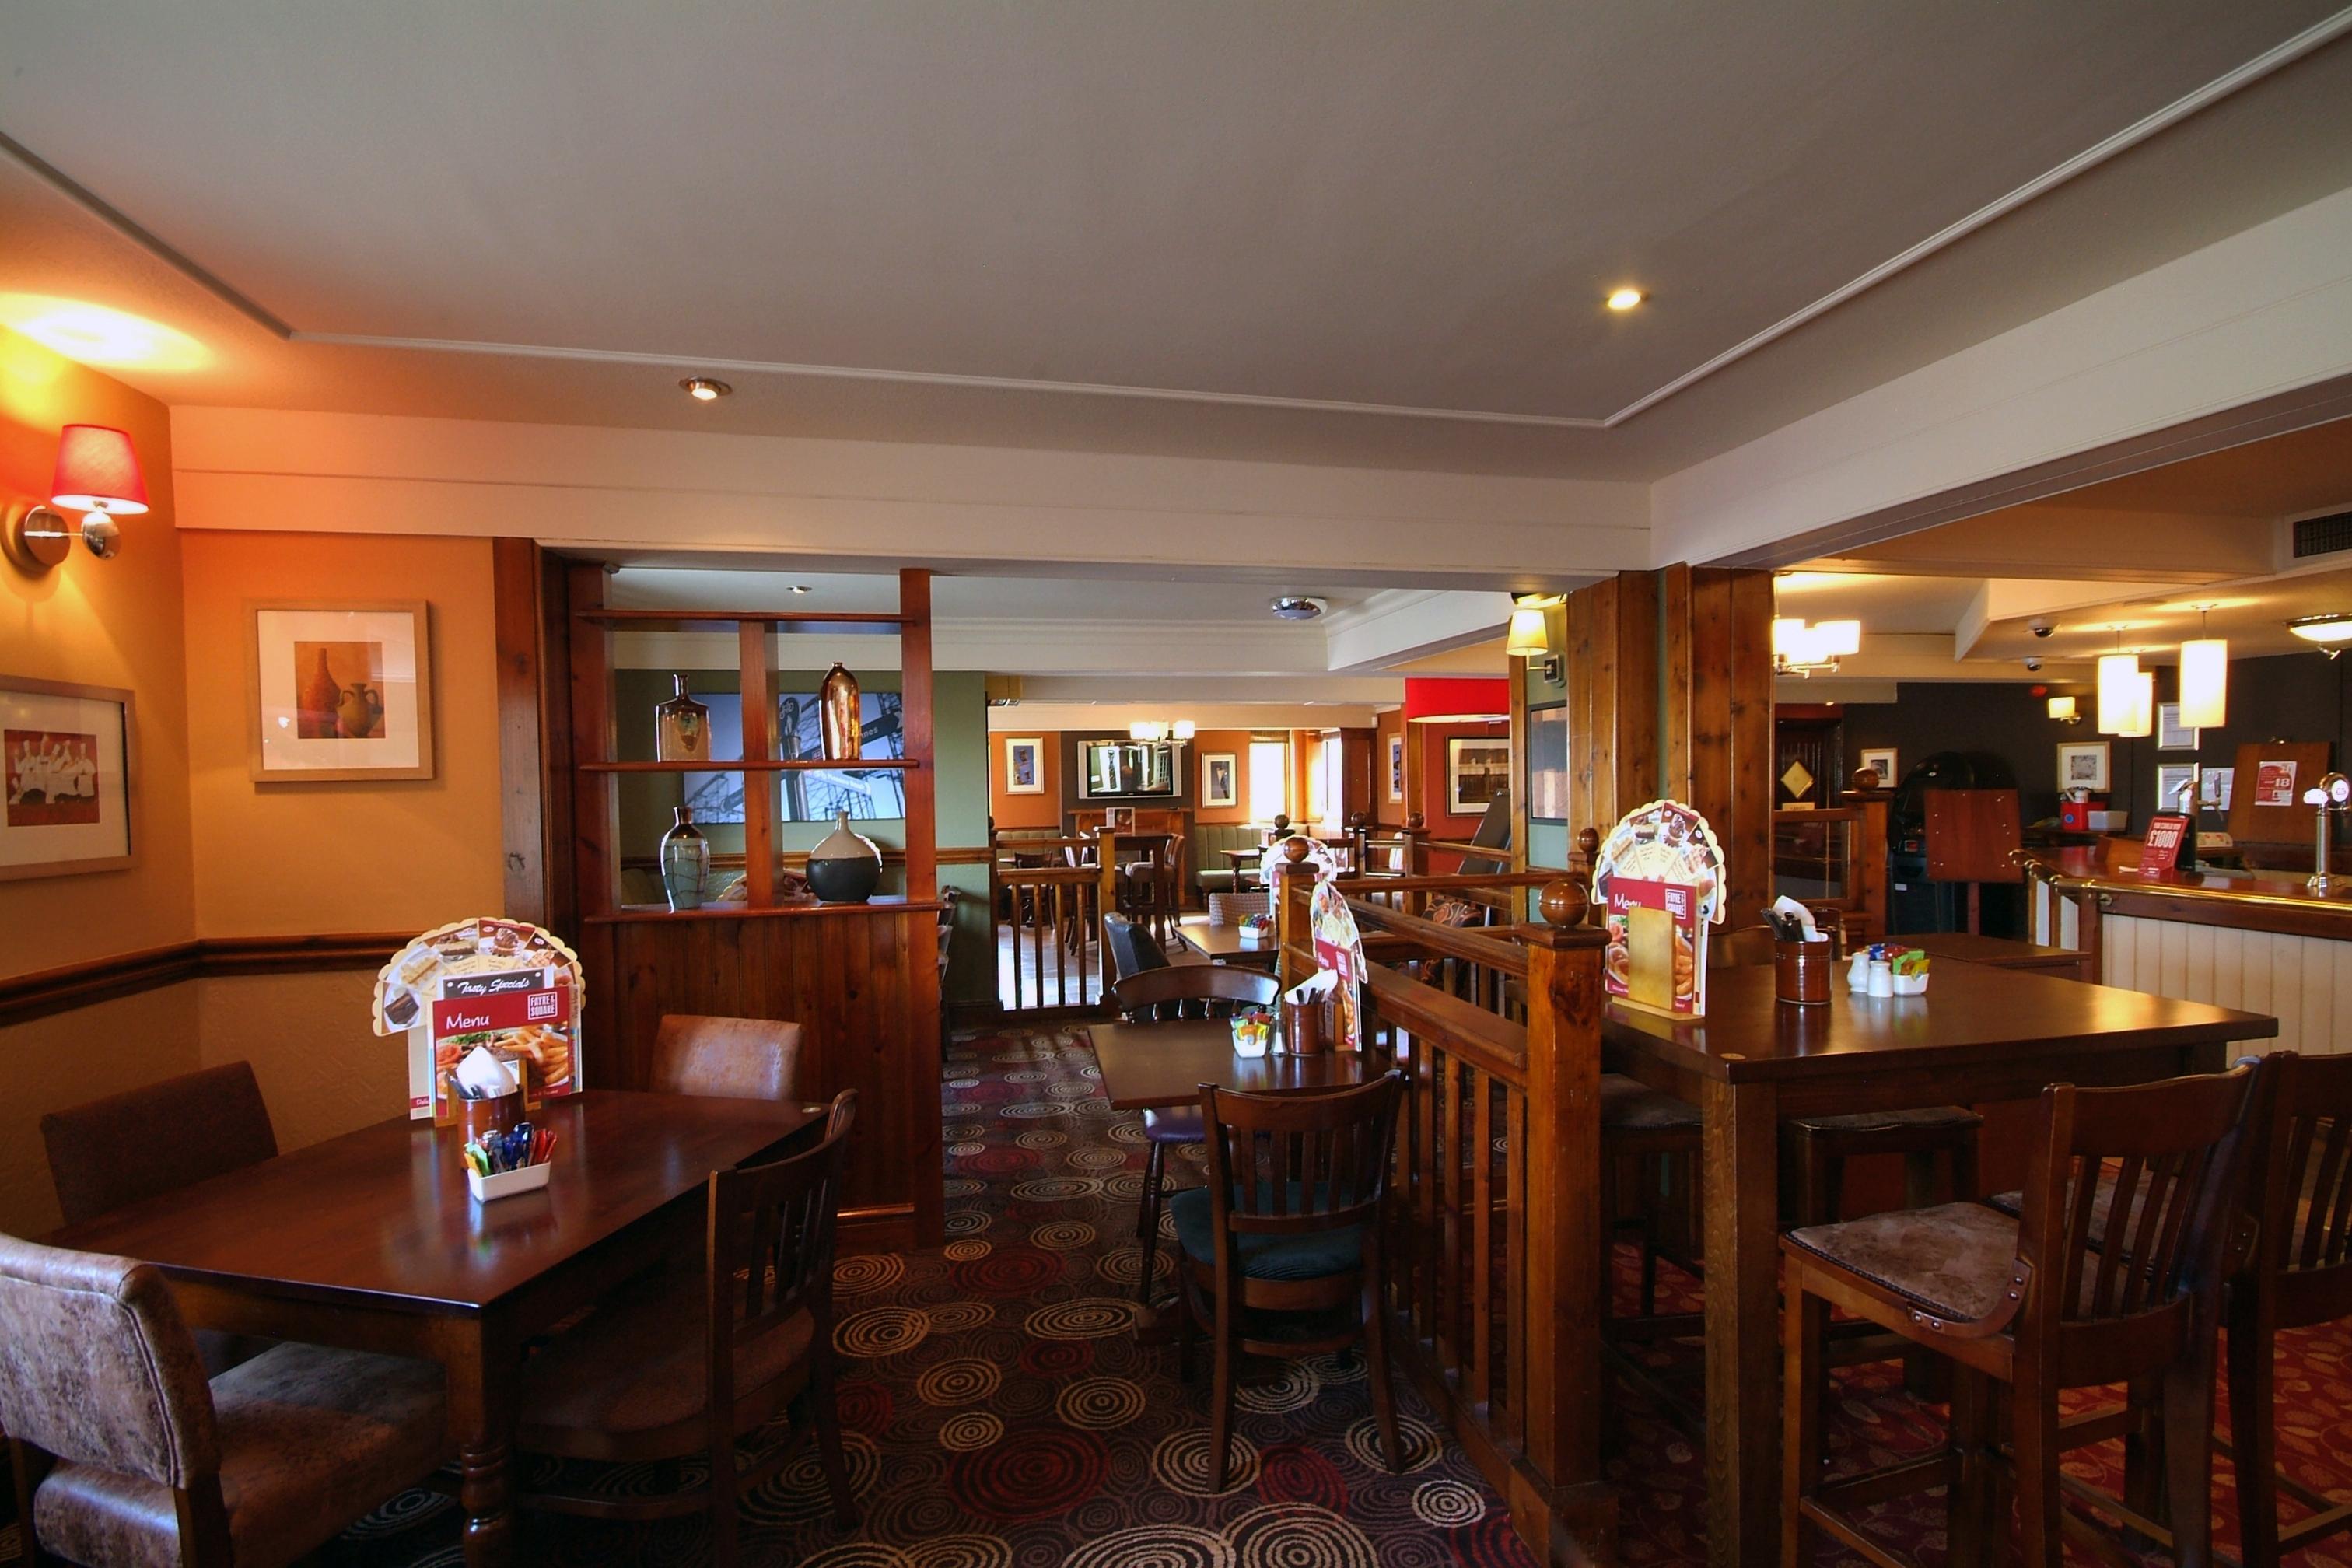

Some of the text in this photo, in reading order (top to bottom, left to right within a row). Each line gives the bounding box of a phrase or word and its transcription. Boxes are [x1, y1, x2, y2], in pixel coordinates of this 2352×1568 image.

[2275, 778, 2291, 787] 18
[2147, 829, 2179, 849] £1000
[457, 977, 530, 996] Tasty Specials
[530, 995, 550, 1007] FAYRE
[530, 1005, 555, 1017] SQUARE
[446, 1013, 490, 1030] Menu
